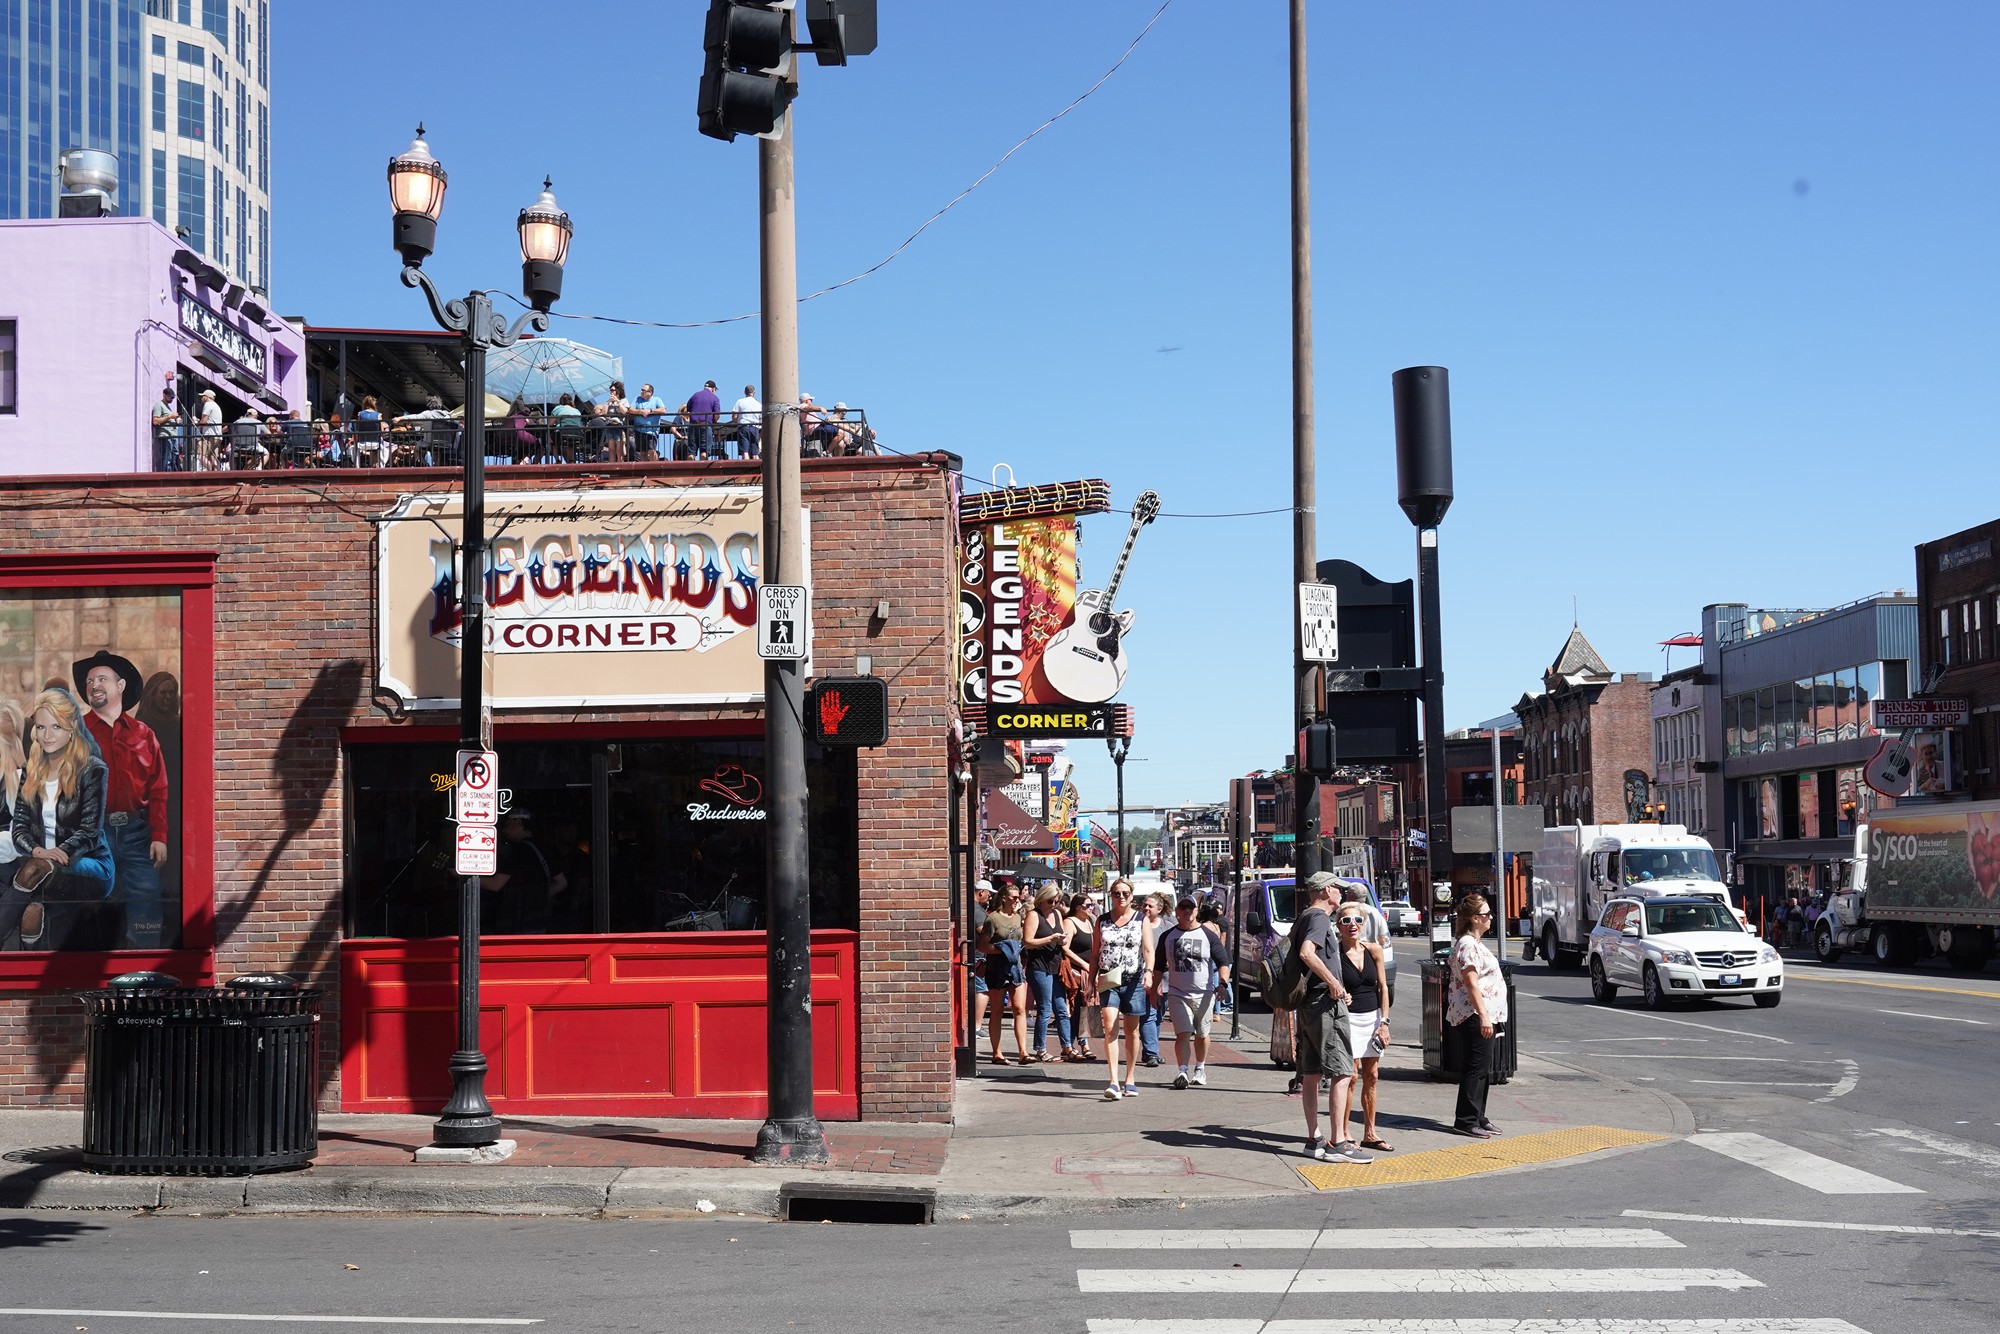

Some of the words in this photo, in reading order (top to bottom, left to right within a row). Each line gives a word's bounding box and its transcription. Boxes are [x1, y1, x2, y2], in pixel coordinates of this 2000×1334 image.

[429, 531, 759, 635] LEGENDS
[766, 588, 799, 598] CROSS
[1305, 587, 1332, 603] DIAGONAL
[769, 599, 795, 609] ONLY
[1305, 602, 1333, 617] CROSSING
[776, 609, 789, 619] ON
[991, 525, 1024, 703] LEGENDS
[503, 622, 677, 648] CORNER
[1304, 622, 1318, 649] OK
[765, 645, 797, 655] SIGNAL
[1878, 701, 1927, 713] ERNEST
[1933, 700, 1966, 711] TUBB
[997, 714, 1088, 729] CORNER
[1885, 714, 1928, 726] RECORD
[1932, 713, 1961, 725] SHOP
[1016, 784, 1041, 792] PRAYERS
[460, 791, 468, 799] OR
[686, 802, 767, 821] Budweise
[998, 823, 1038, 837] Second
[994, 834, 1038, 849] Fiddle
[1931, 838, 1943, 847] heart
[1917, 848, 1927, 856] food
